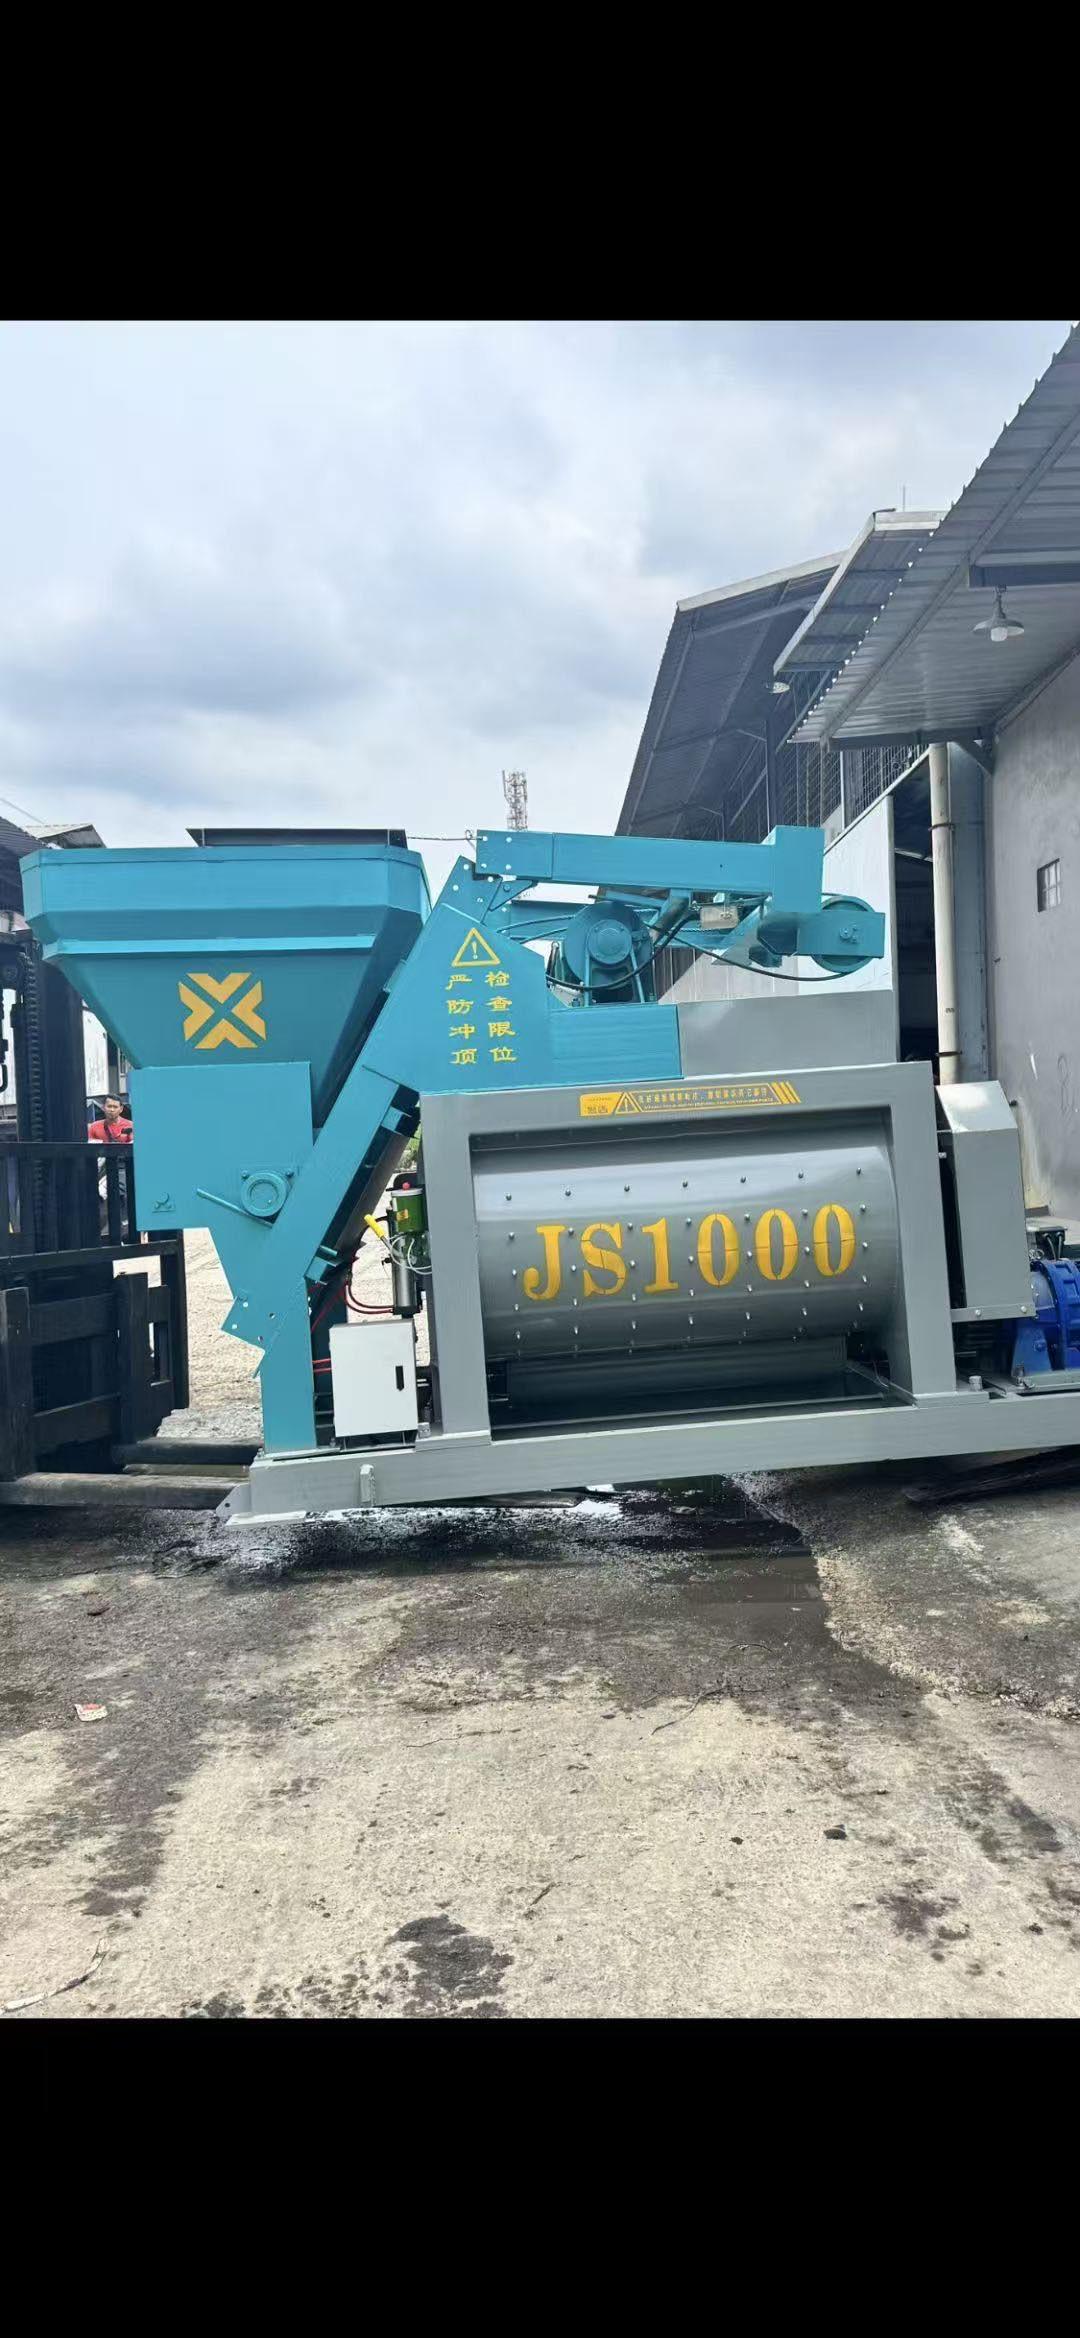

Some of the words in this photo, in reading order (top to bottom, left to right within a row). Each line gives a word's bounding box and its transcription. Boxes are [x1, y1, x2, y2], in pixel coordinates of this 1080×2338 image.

[446, 973, 477, 1065] 严防冲顶
[486, 970, 517, 1062] 检查限位
[523, 1204, 856, 1301] JS1000
